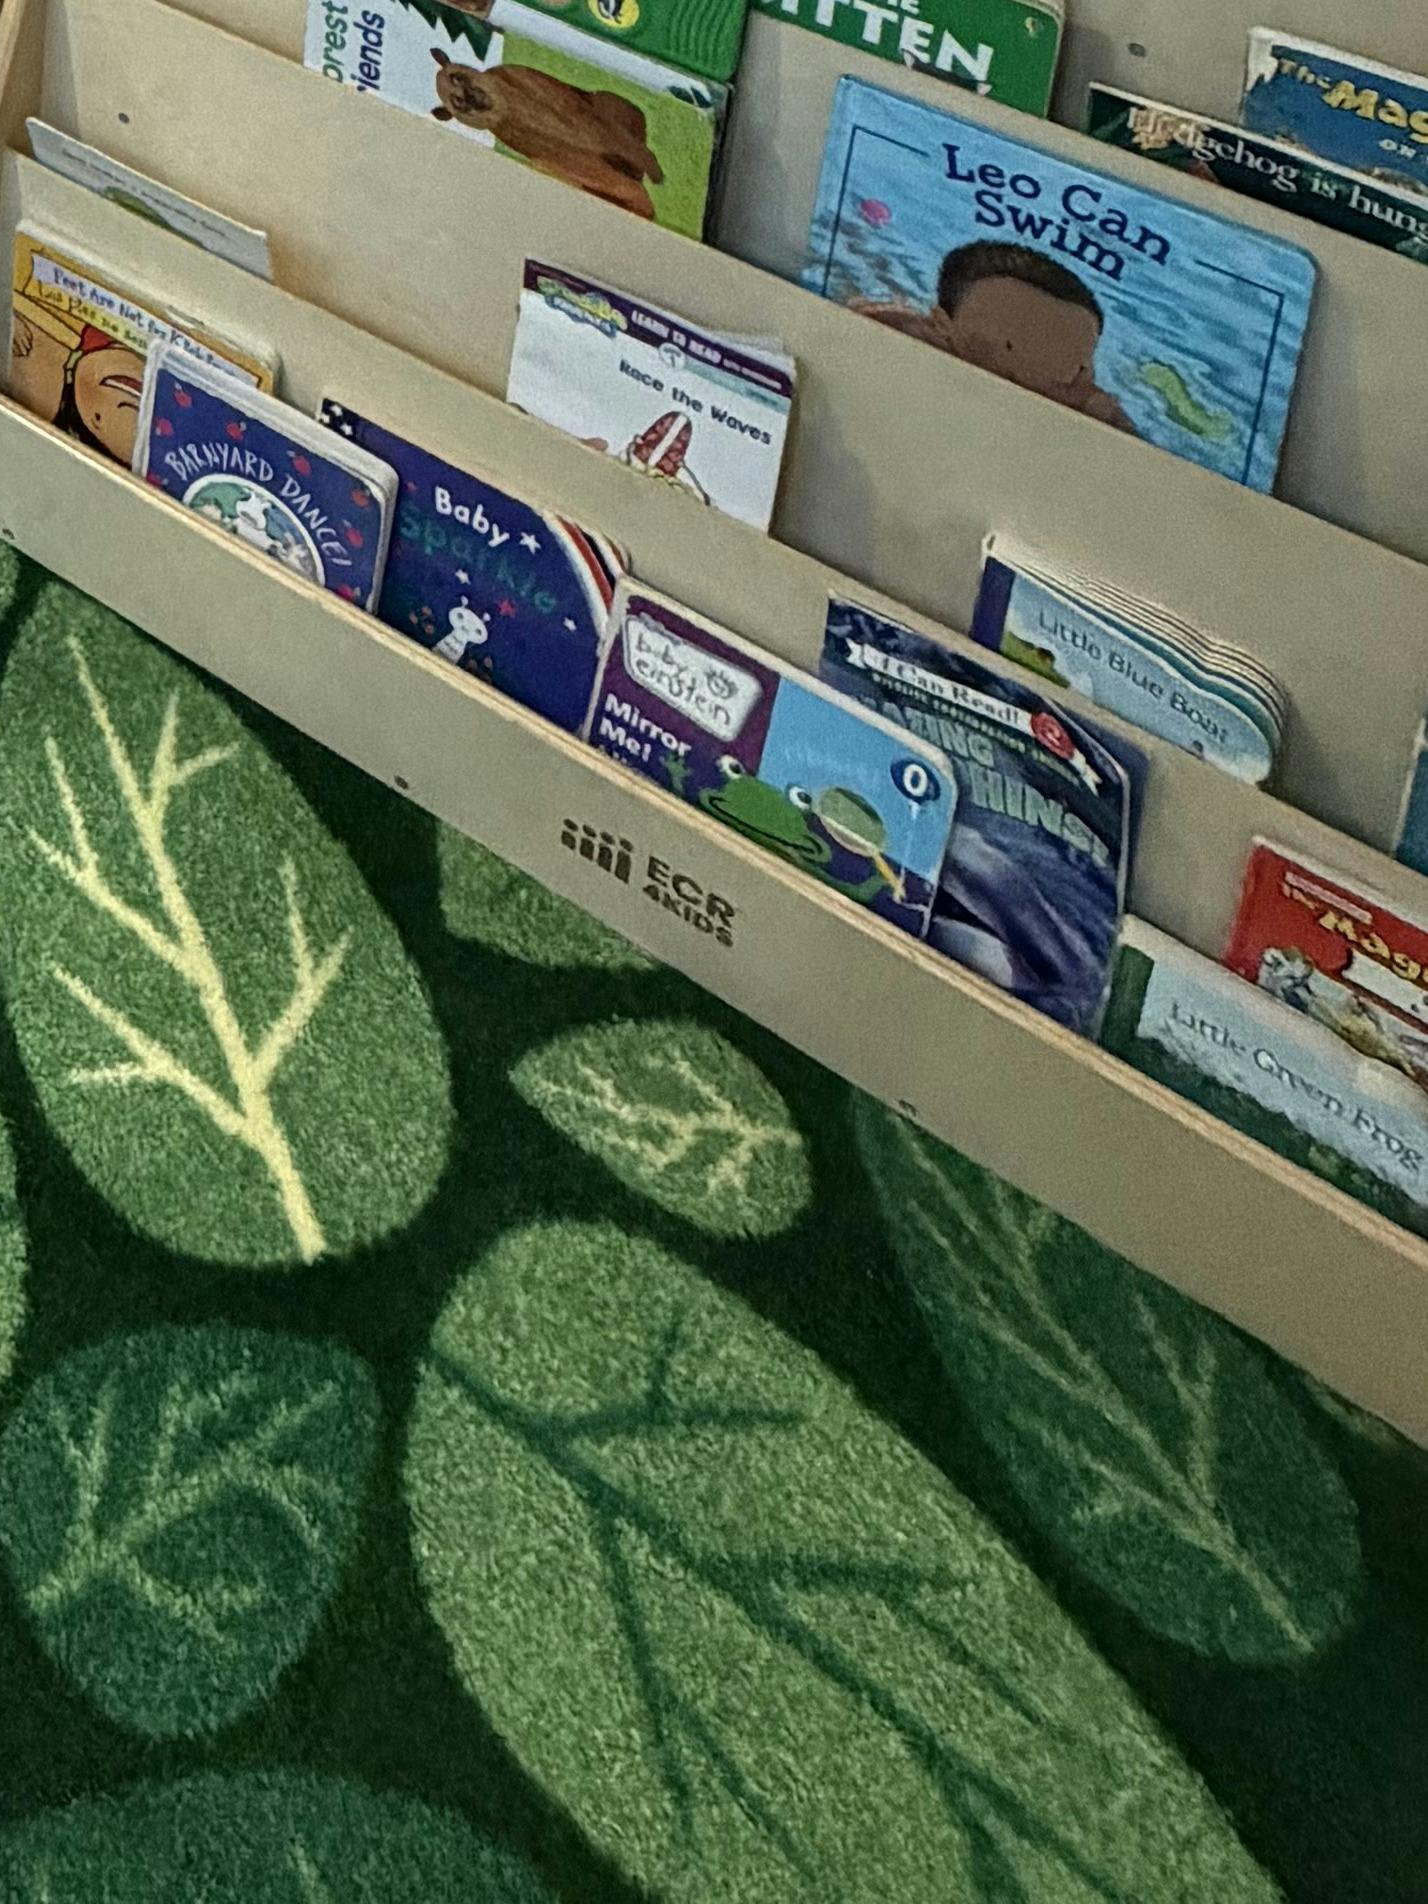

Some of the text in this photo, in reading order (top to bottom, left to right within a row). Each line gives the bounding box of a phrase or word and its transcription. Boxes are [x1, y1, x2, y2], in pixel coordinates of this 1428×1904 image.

[322, 0, 351, 84] orest
[356, 9, 387, 95] iends
[1277, 57, 1428, 145] The Mag
[943, 141, 1173, 267] Leo Can
[974, 192, 1126, 283] Swim
[1310, 172, 1338, 201] is
[1347, 184, 1428, 245] hung
[619, 358, 774, 446] Race the Waves
[164, 441, 353, 567] BARNYARD DANCE!
[434, 485, 511, 548] Baby
[896, 665, 946, 696] Can
[952, 685, 1021, 726] Read!
[1037, 610, 1229, 746] Little Blue Boat
[604, 693, 693, 757] Mirror
[643, 884, 734, 948] 4KIDS
[646, 855, 736, 928] ECR
[1170, 1000, 1425, 1173] Little Green Frog
